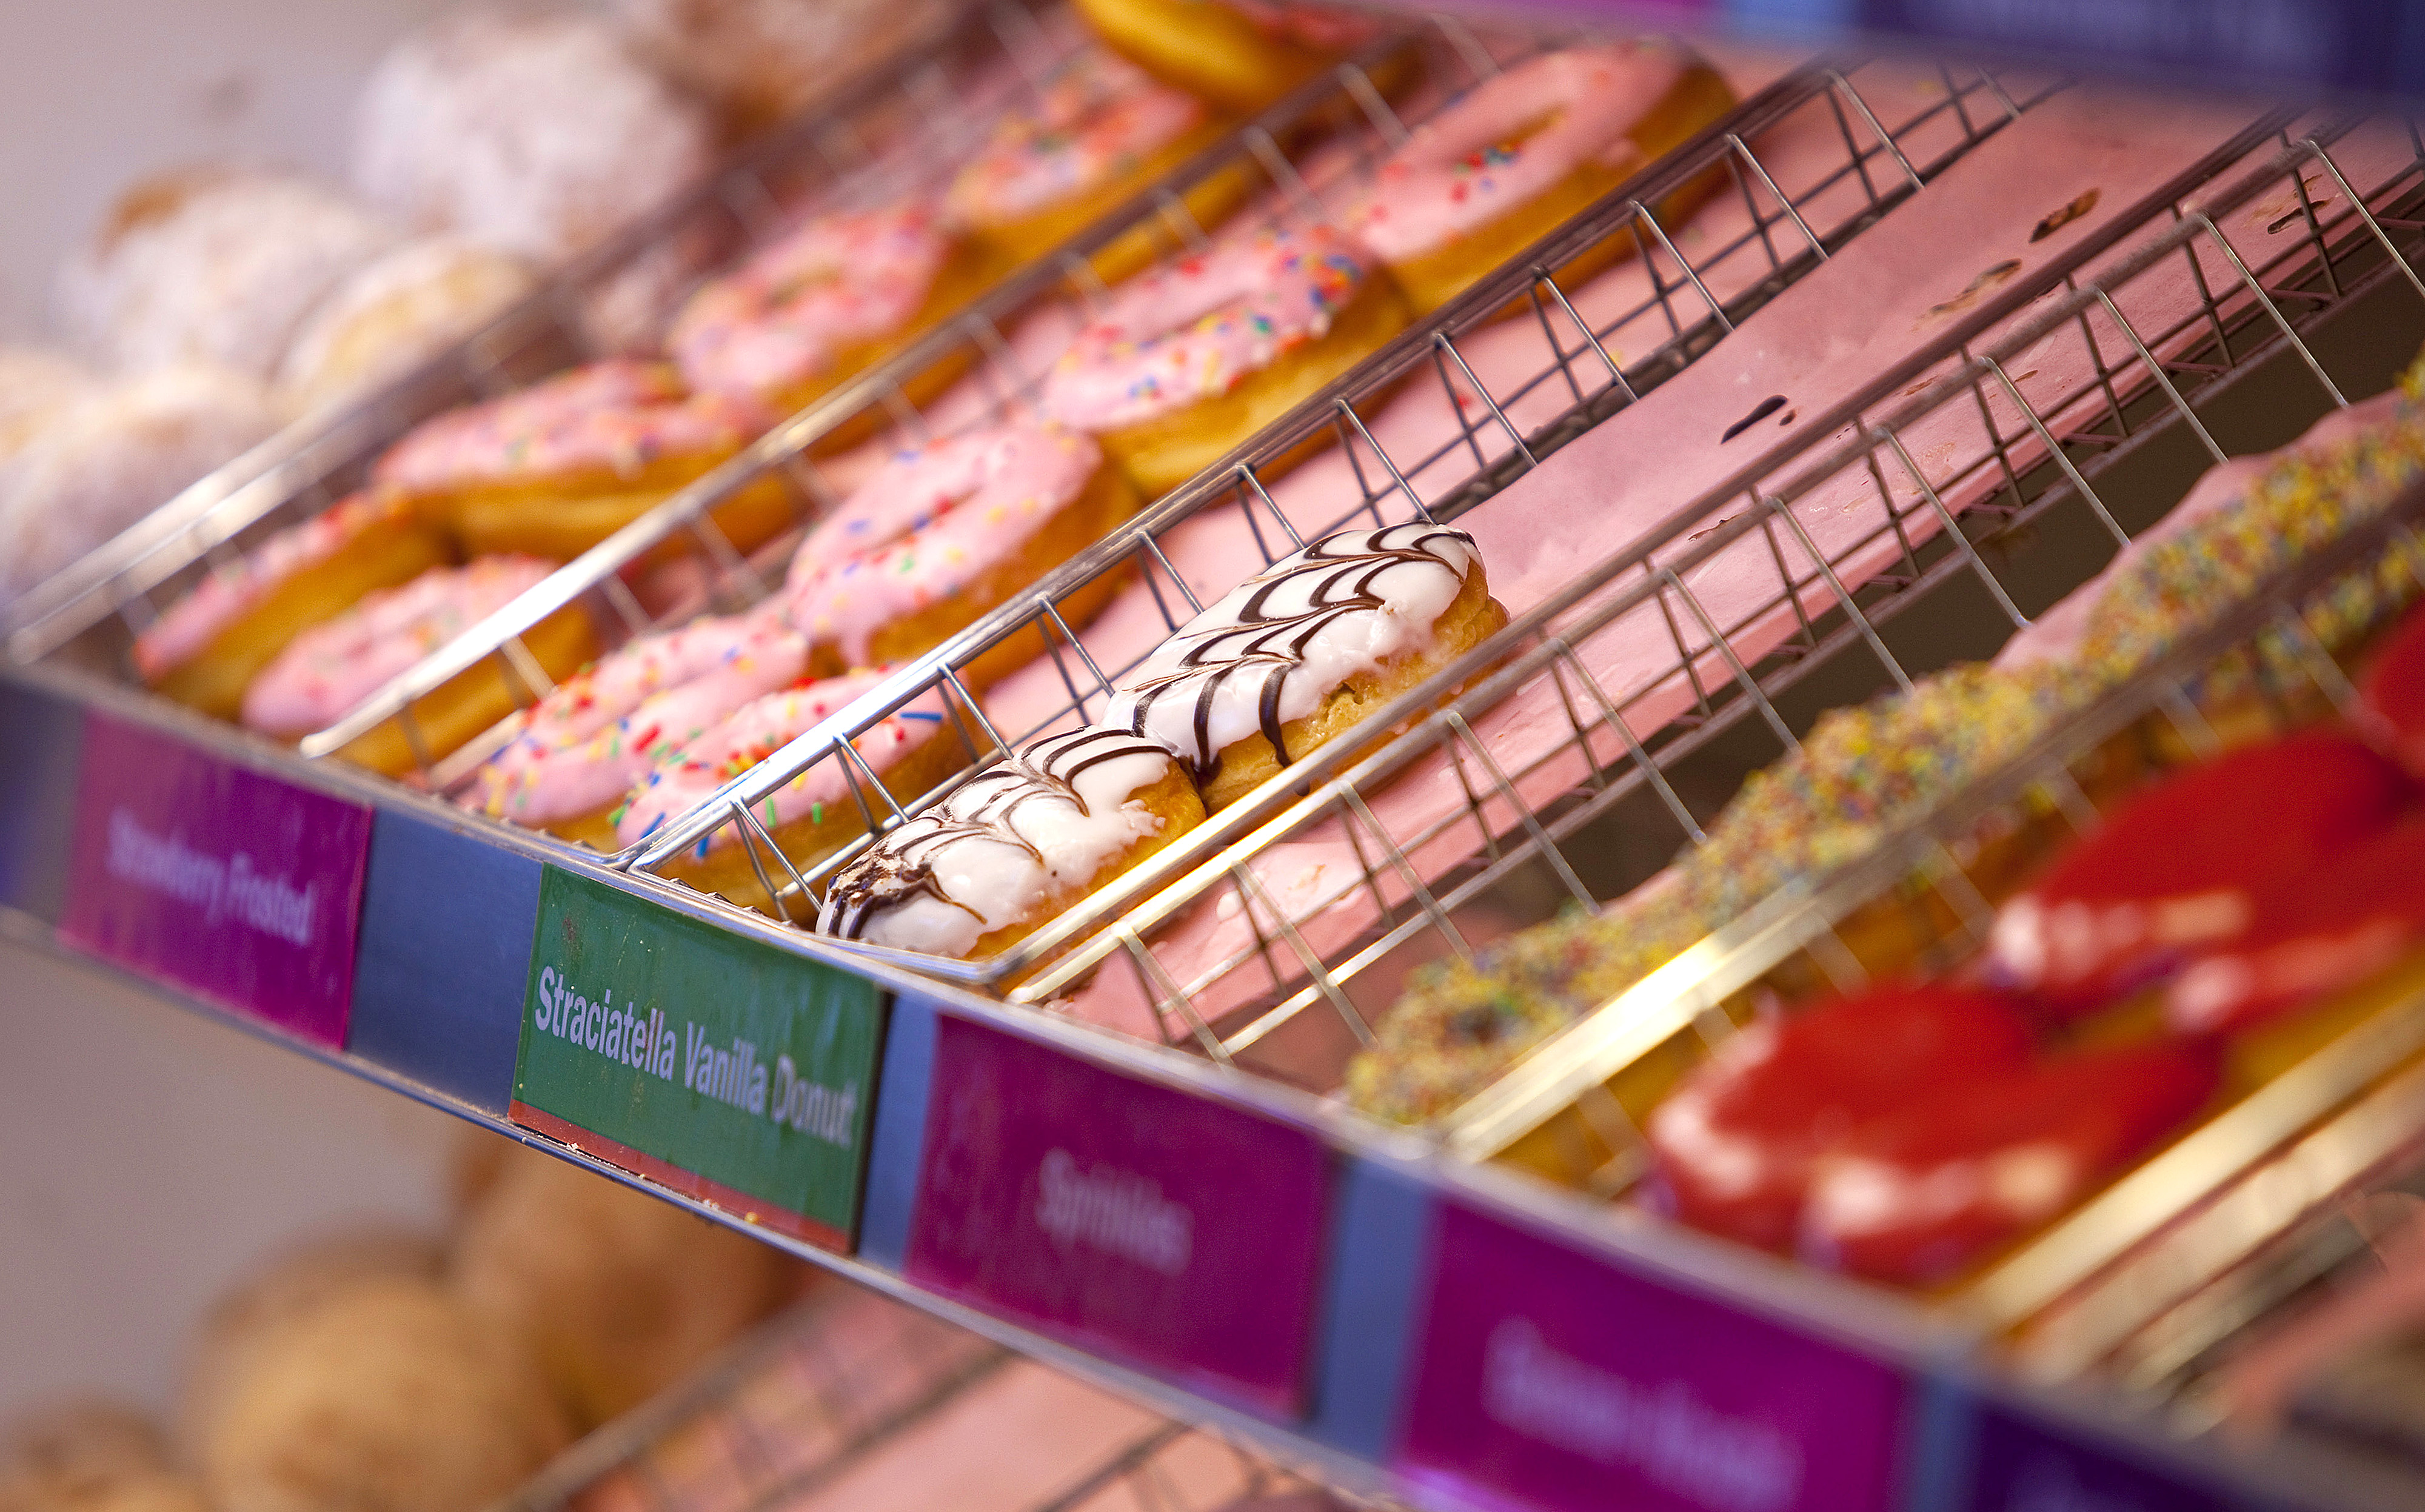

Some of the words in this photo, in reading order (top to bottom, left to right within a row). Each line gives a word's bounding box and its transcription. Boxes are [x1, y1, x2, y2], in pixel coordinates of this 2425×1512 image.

[534, 966, 677, 1081] Straciatella
[684, 1021, 769, 1116] Vanilla
[771, 1054, 858, 1148] Donut
